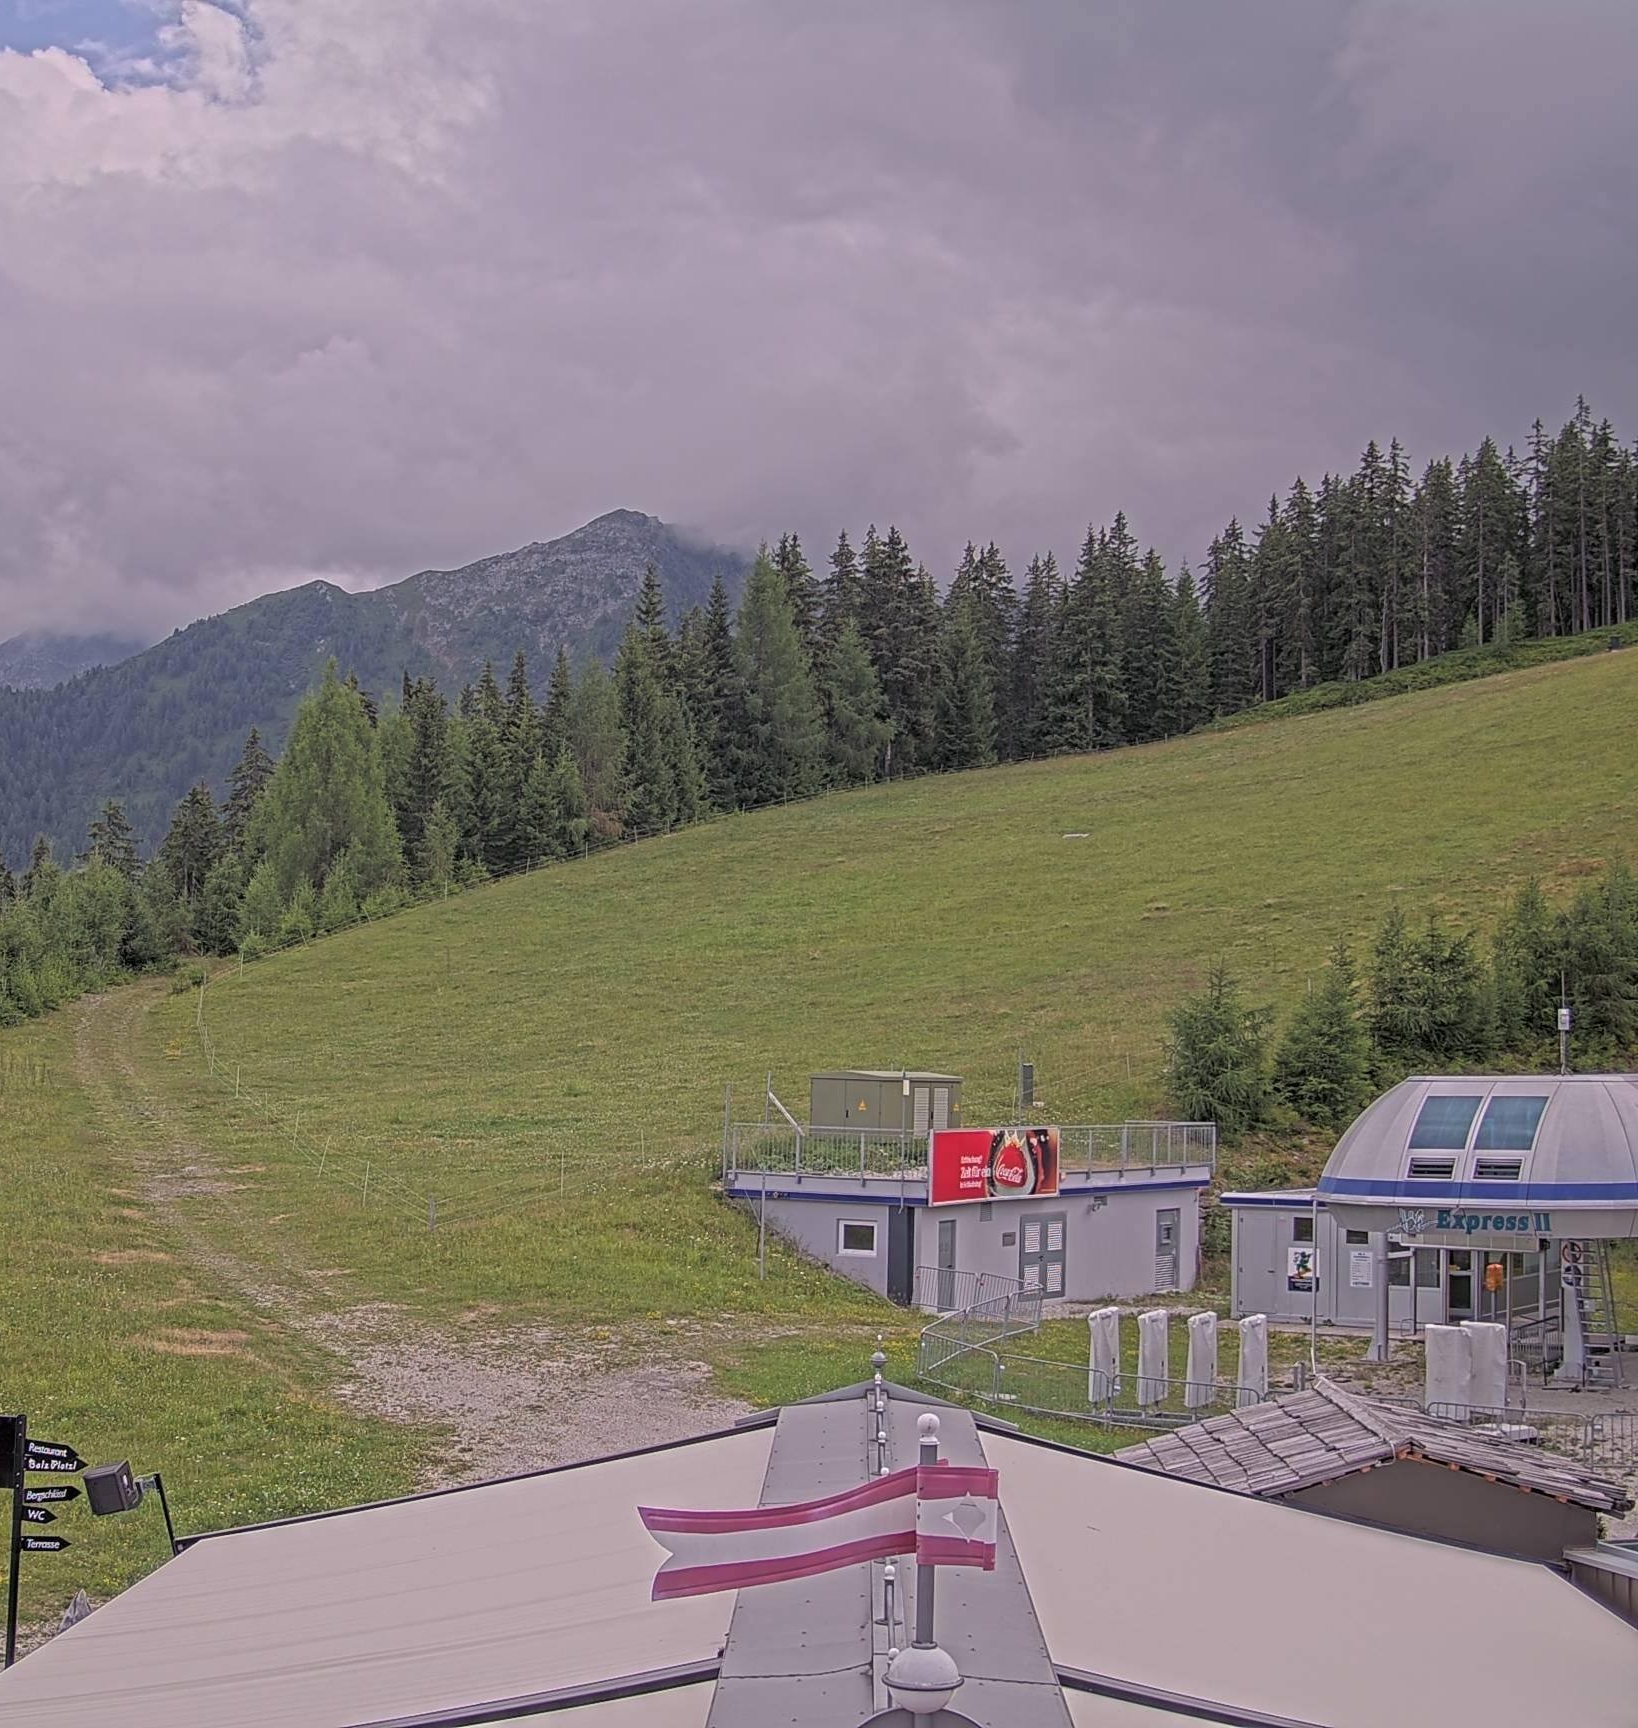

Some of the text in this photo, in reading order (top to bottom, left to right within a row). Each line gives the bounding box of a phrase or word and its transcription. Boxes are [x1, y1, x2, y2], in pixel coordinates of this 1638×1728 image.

[1436, 1209, 1529, 1234] Express
[1534, 1212, 1551, 1232] II
[28, 1443, 67, 1457] Restaurant
[27, 1510, 46, 1520] WC
[26, 1538, 60, 1549] Terrasse
